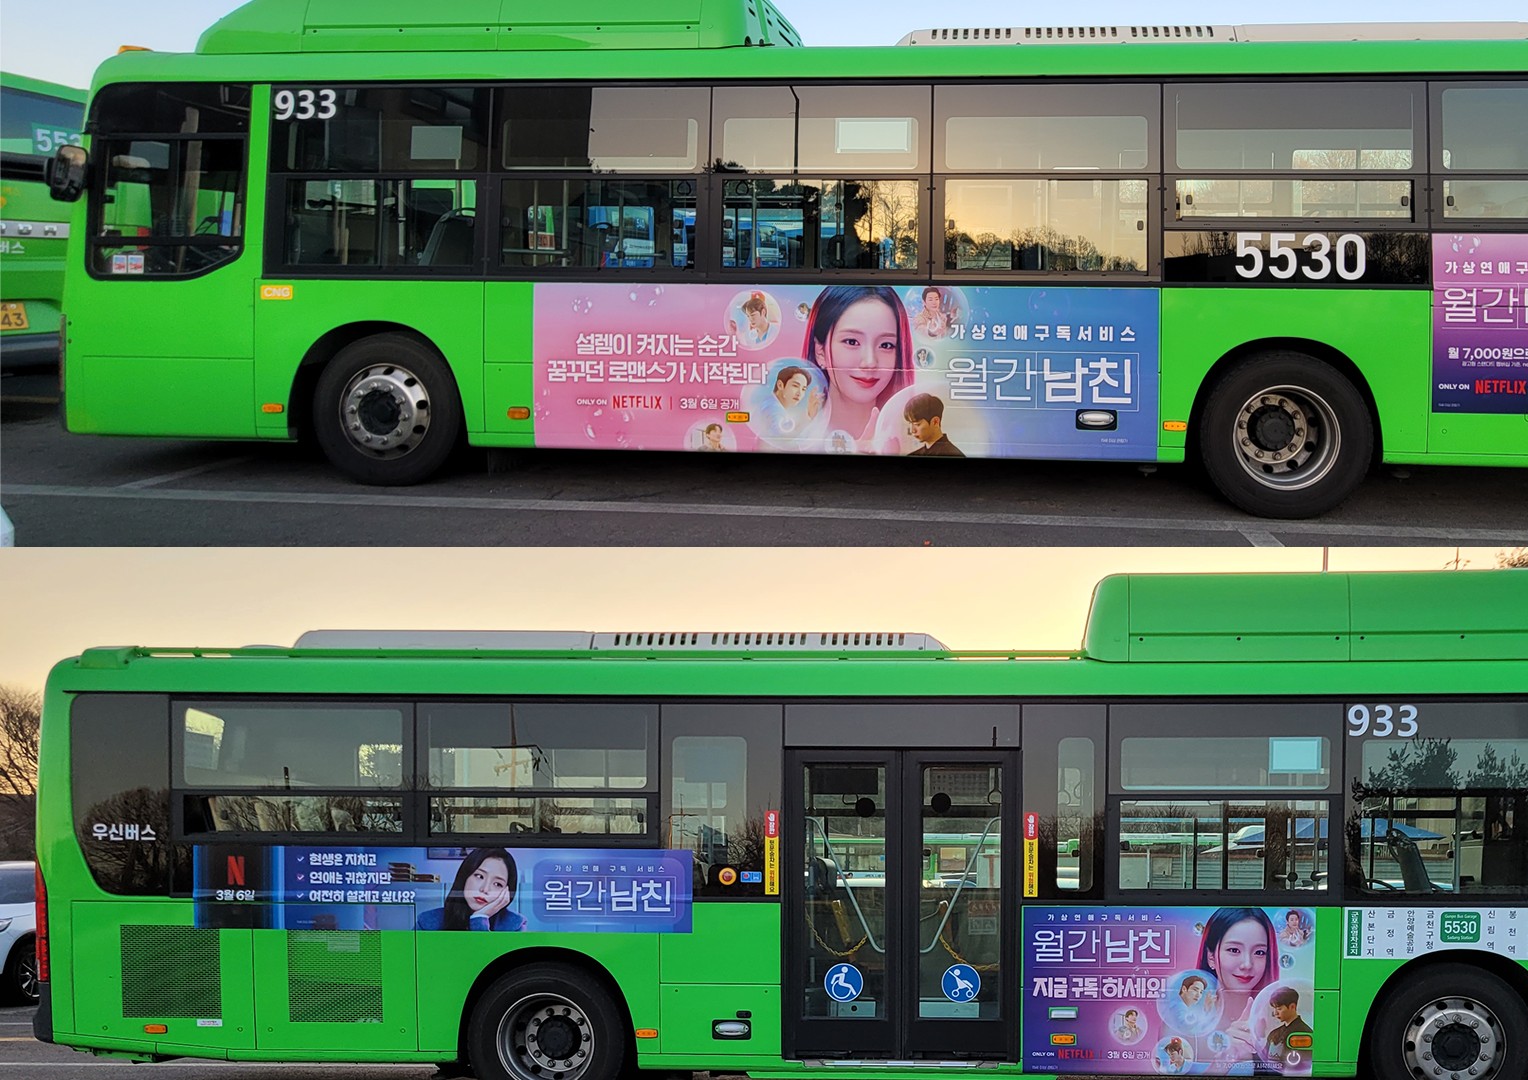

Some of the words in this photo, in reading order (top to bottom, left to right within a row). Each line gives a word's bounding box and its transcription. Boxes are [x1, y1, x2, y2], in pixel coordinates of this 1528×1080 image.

[274, 89, 337, 120] 933
[1234, 232, 1367, 281] 5530
[263, 287, 291, 297] CNG
[576, 333, 632, 355] 설렘이
[637, 333, 694, 356] 켜지는
[698, 334, 739, 357] 순간
[950, 324, 1136, 342] 가상연애구독서비스
[1448, 347, 1459, 360] 월
[547, 360, 604, 383] 꿈꾸던
[608, 361, 687, 384] 로맨스가
[690, 362, 768, 385] 시작된다
[946, 357, 1133, 404] 월간남친
[1475, 380, 1527, 395] NETFLIX
[576, 398, 596, 406] ONLY
[596, 398, 608, 406] ON
[612, 395, 662, 410] NETFLIX
[680, 398, 698, 410] 3월
[699, 398, 718, 410] 6일
[720, 399, 740, 410] 공개
[1348, 704, 1418, 737] 933
[93, 823, 156, 841] 우신버스
[227, 856, 245, 886] N
[309, 853, 343, 866] 현생은
[345, 853, 376, 866] 지치고
[309, 872, 343, 885] 연애는
[345, 872, 391, 885] 귀찮지만
[216, 890, 234, 901] 3월
[236, 890, 255, 901] 6일
[309, 890, 344, 902] 여전히
[347, 891, 380, 902] 설레고
[382, 891, 416, 903] 싶나요?
[543, 880, 671, 912] 월간남친
[1366, 910, 1376, 956] 산본단지
[1386, 910, 1395, 956] 금정역
[1426, 910, 1434, 949] 금천구청
[1444, 921, 1476, 934] 5530
[1487, 910, 1495, 950] 신림역
[1508, 910, 1516, 954] 봉천역
[1033, 929, 1170, 963] 월간남친
[1033, 977, 1068, 998] 지금
[1072, 977, 1098, 998] 구독
[1102, 977, 1166, 998] 하세요!
[1058, 1049, 1094, 1059] NETFLIX
[1107, 1051, 1120, 1059] 3월
[1122, 1051, 1134, 1059] 6일
[1136, 1051, 1151, 1059] 공개
